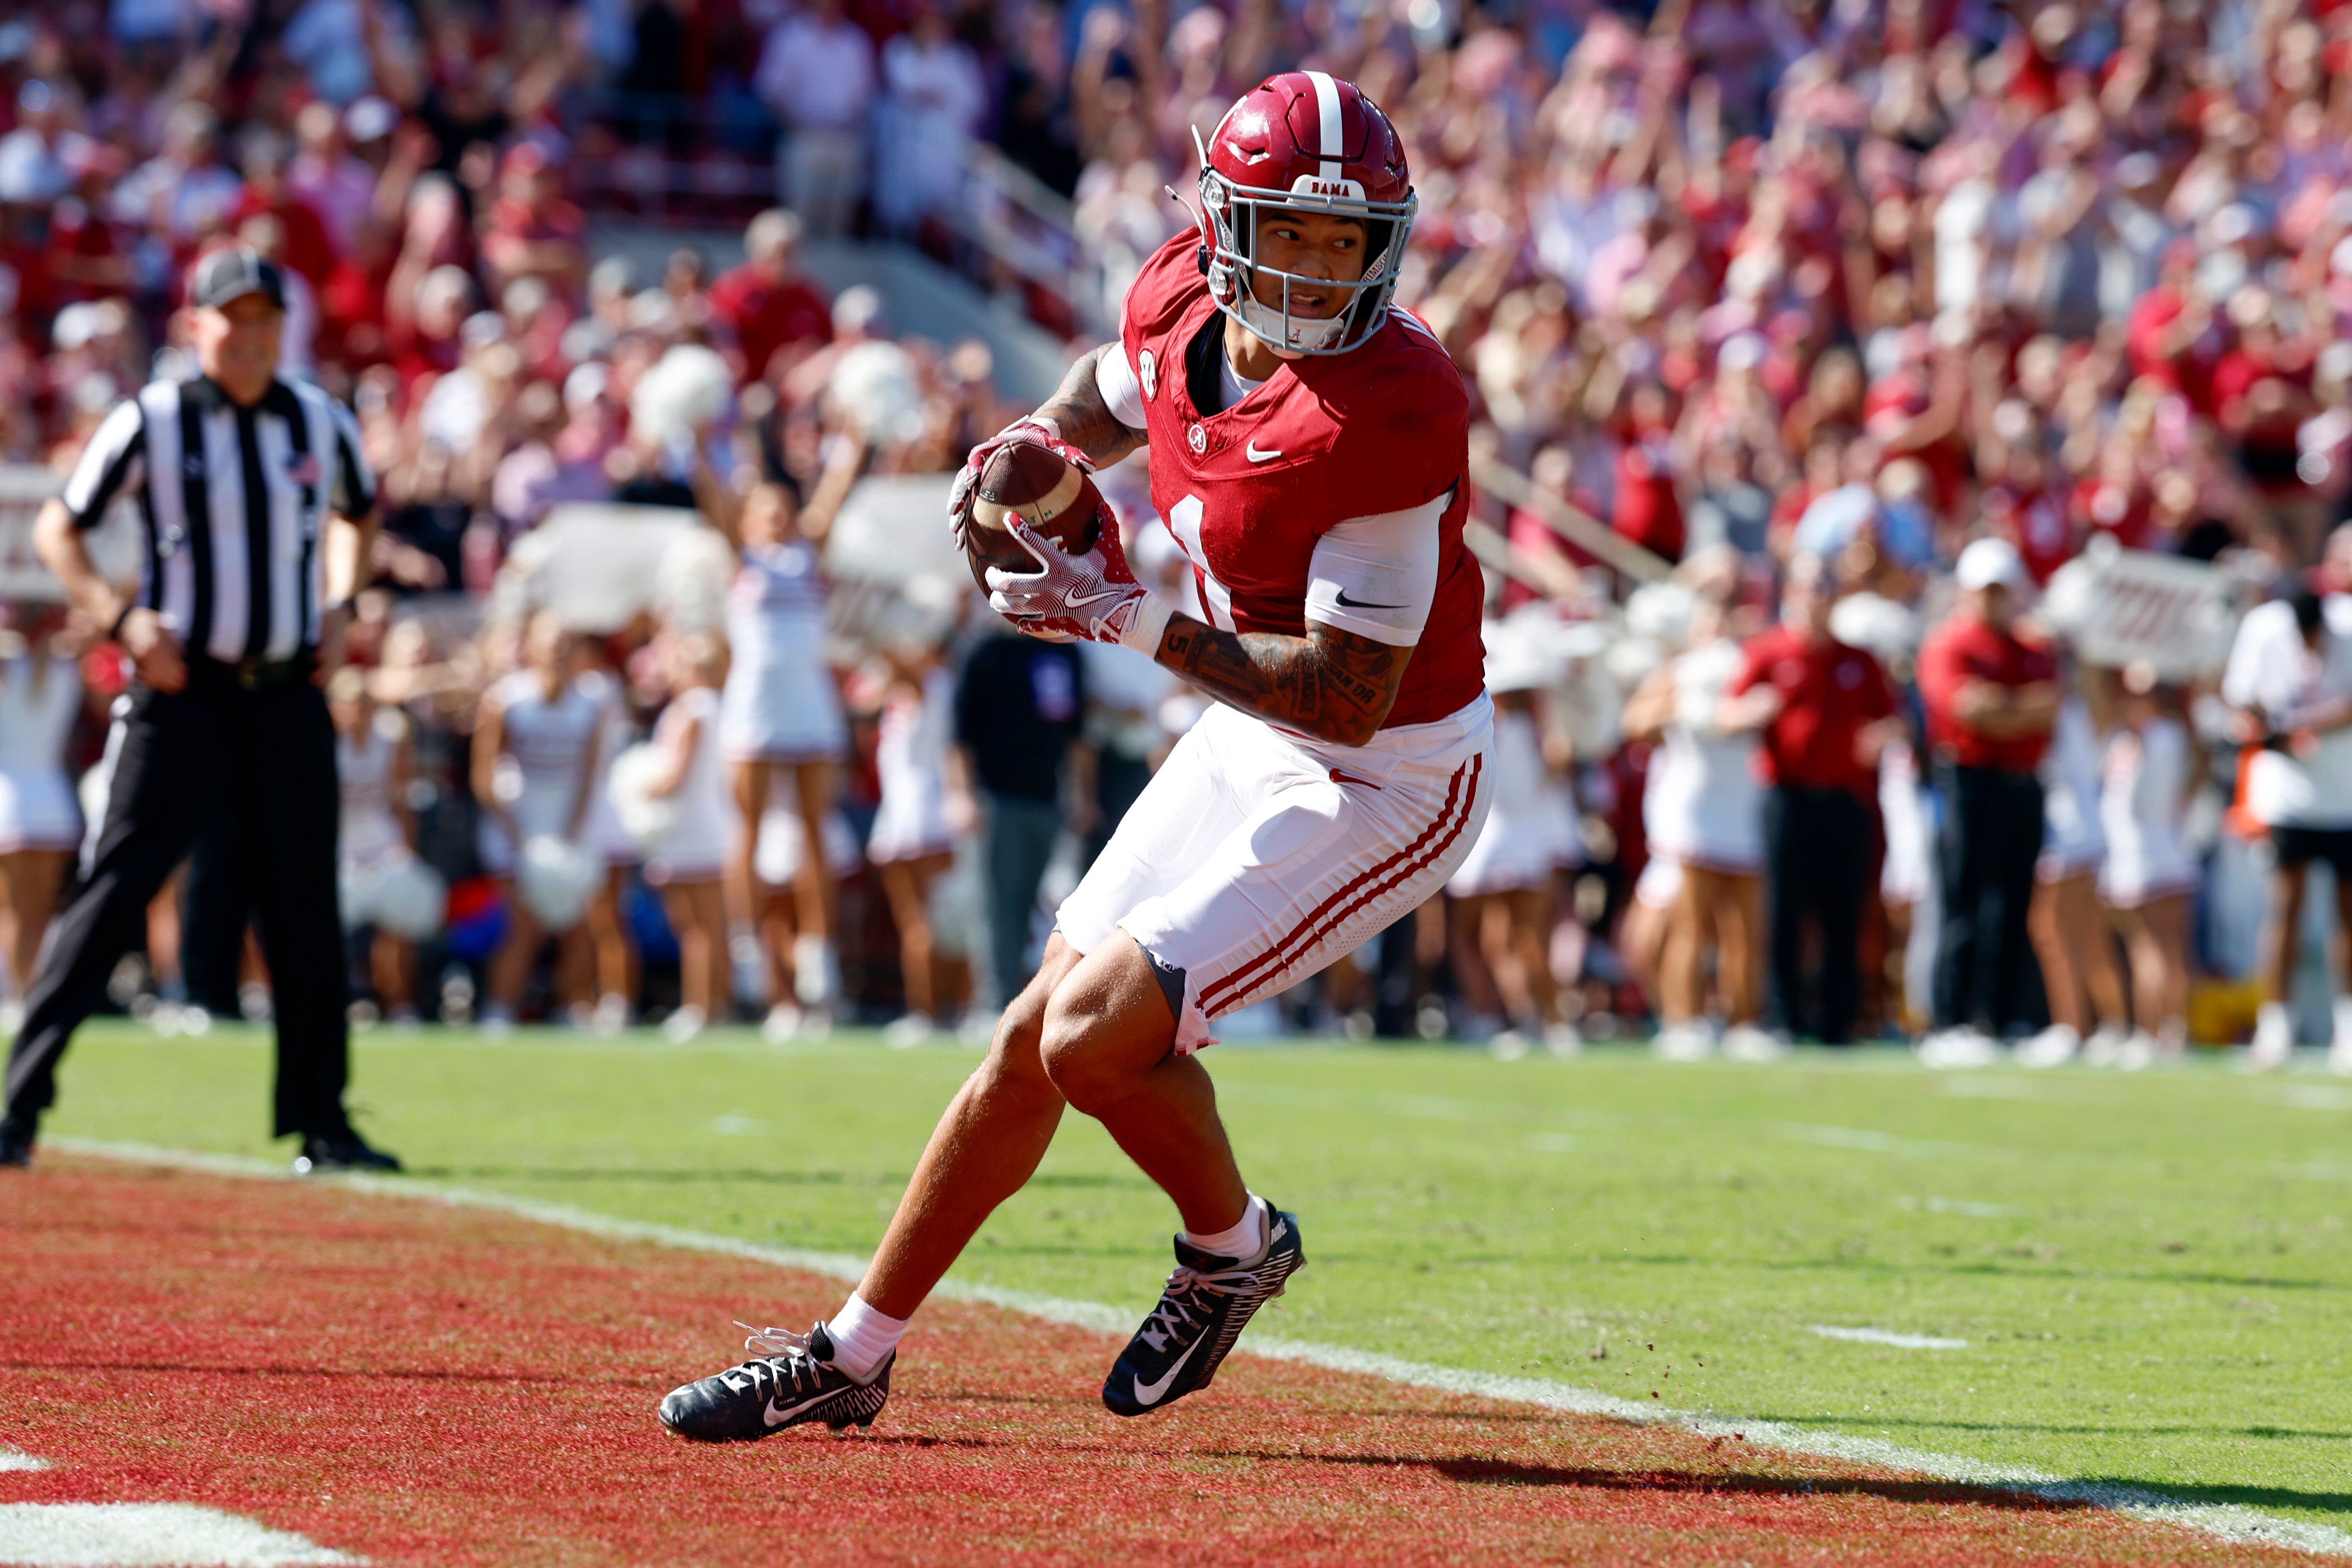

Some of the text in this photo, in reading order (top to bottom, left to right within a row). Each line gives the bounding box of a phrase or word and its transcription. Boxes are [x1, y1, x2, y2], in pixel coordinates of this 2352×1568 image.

[1311, 182, 1350, 197] BAMA
[1167, 632, 1190, 655] 5
[1352, 683, 1376, 705] DR
[1270, 1217, 1288, 1246] NIKE
